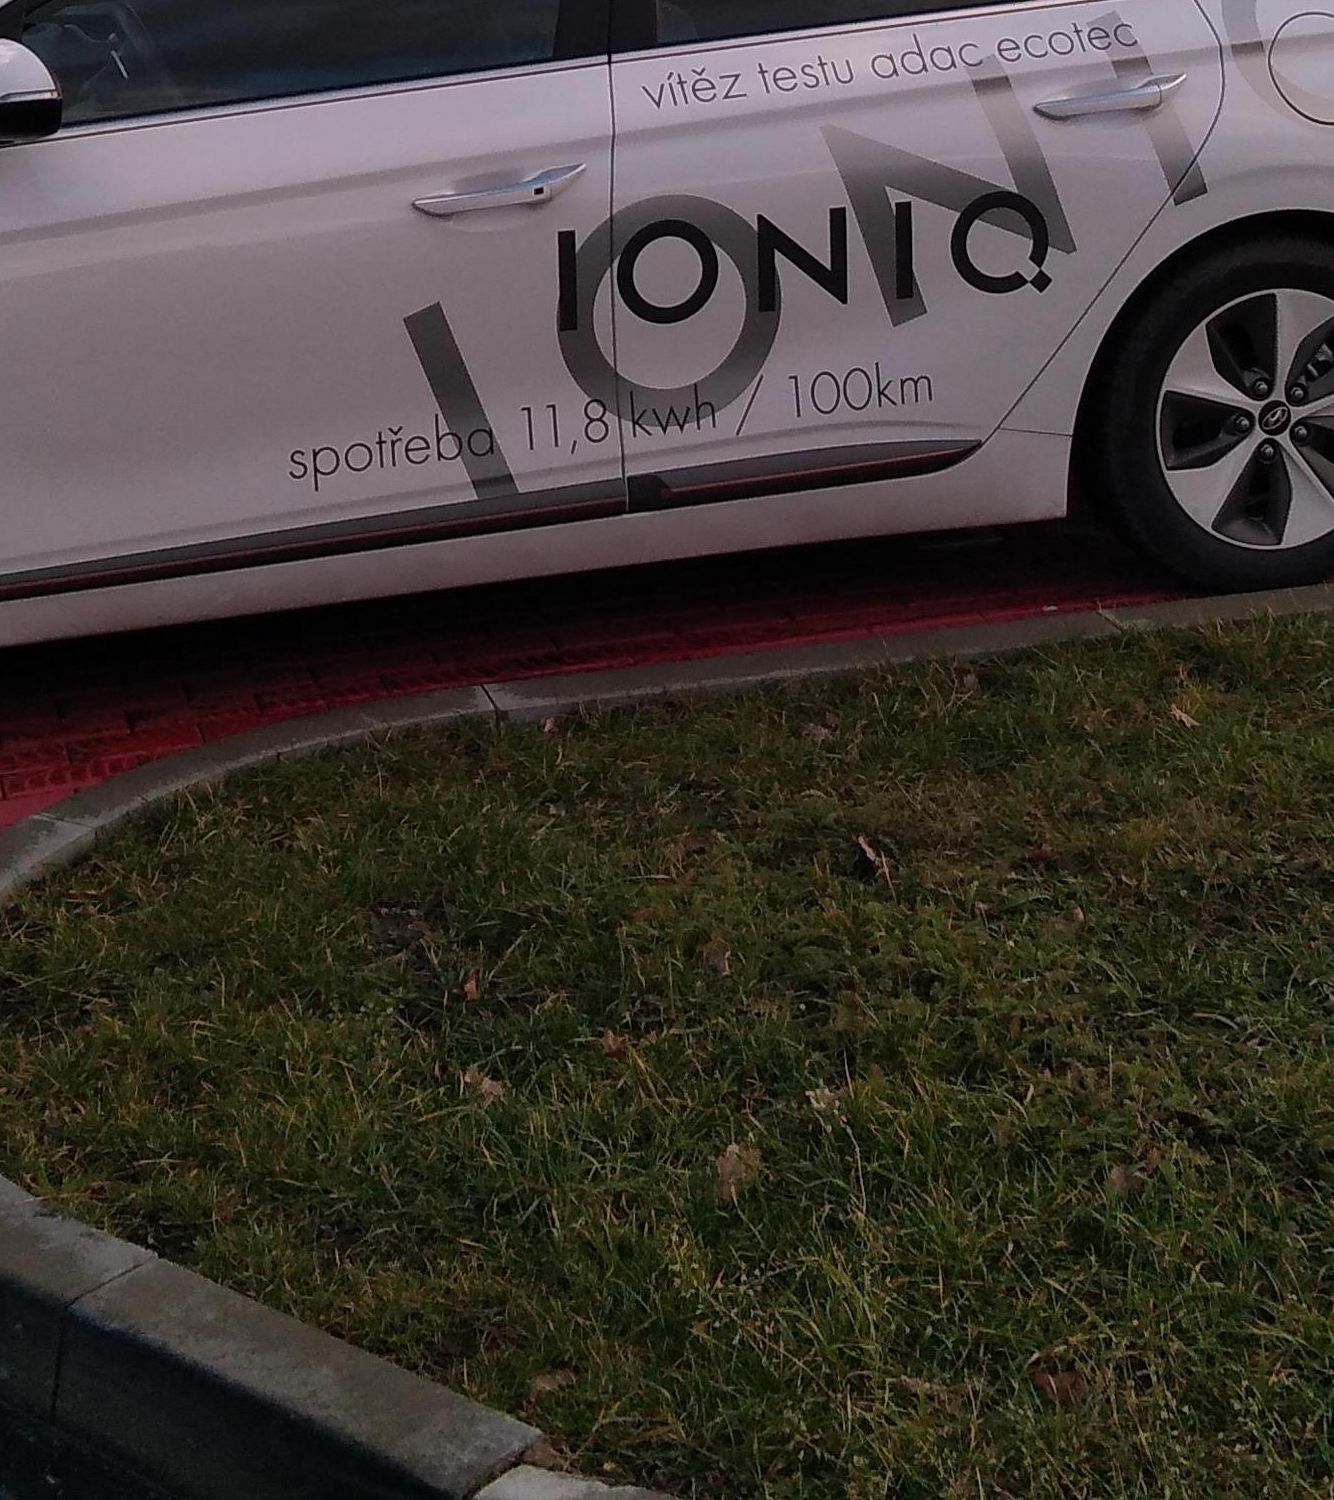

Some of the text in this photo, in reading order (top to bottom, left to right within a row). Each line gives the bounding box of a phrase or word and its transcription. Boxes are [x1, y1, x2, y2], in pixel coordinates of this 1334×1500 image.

[641, 19, 1139, 109] vítěz testu adac ecotec
[556, 190, 1052, 331] IONIQ
[288, 413, 496, 491] spotřeba
[520, 399, 610, 455] 11,8
[630, 383, 716, 439] kwh
[787, 361, 934, 418] 100km
